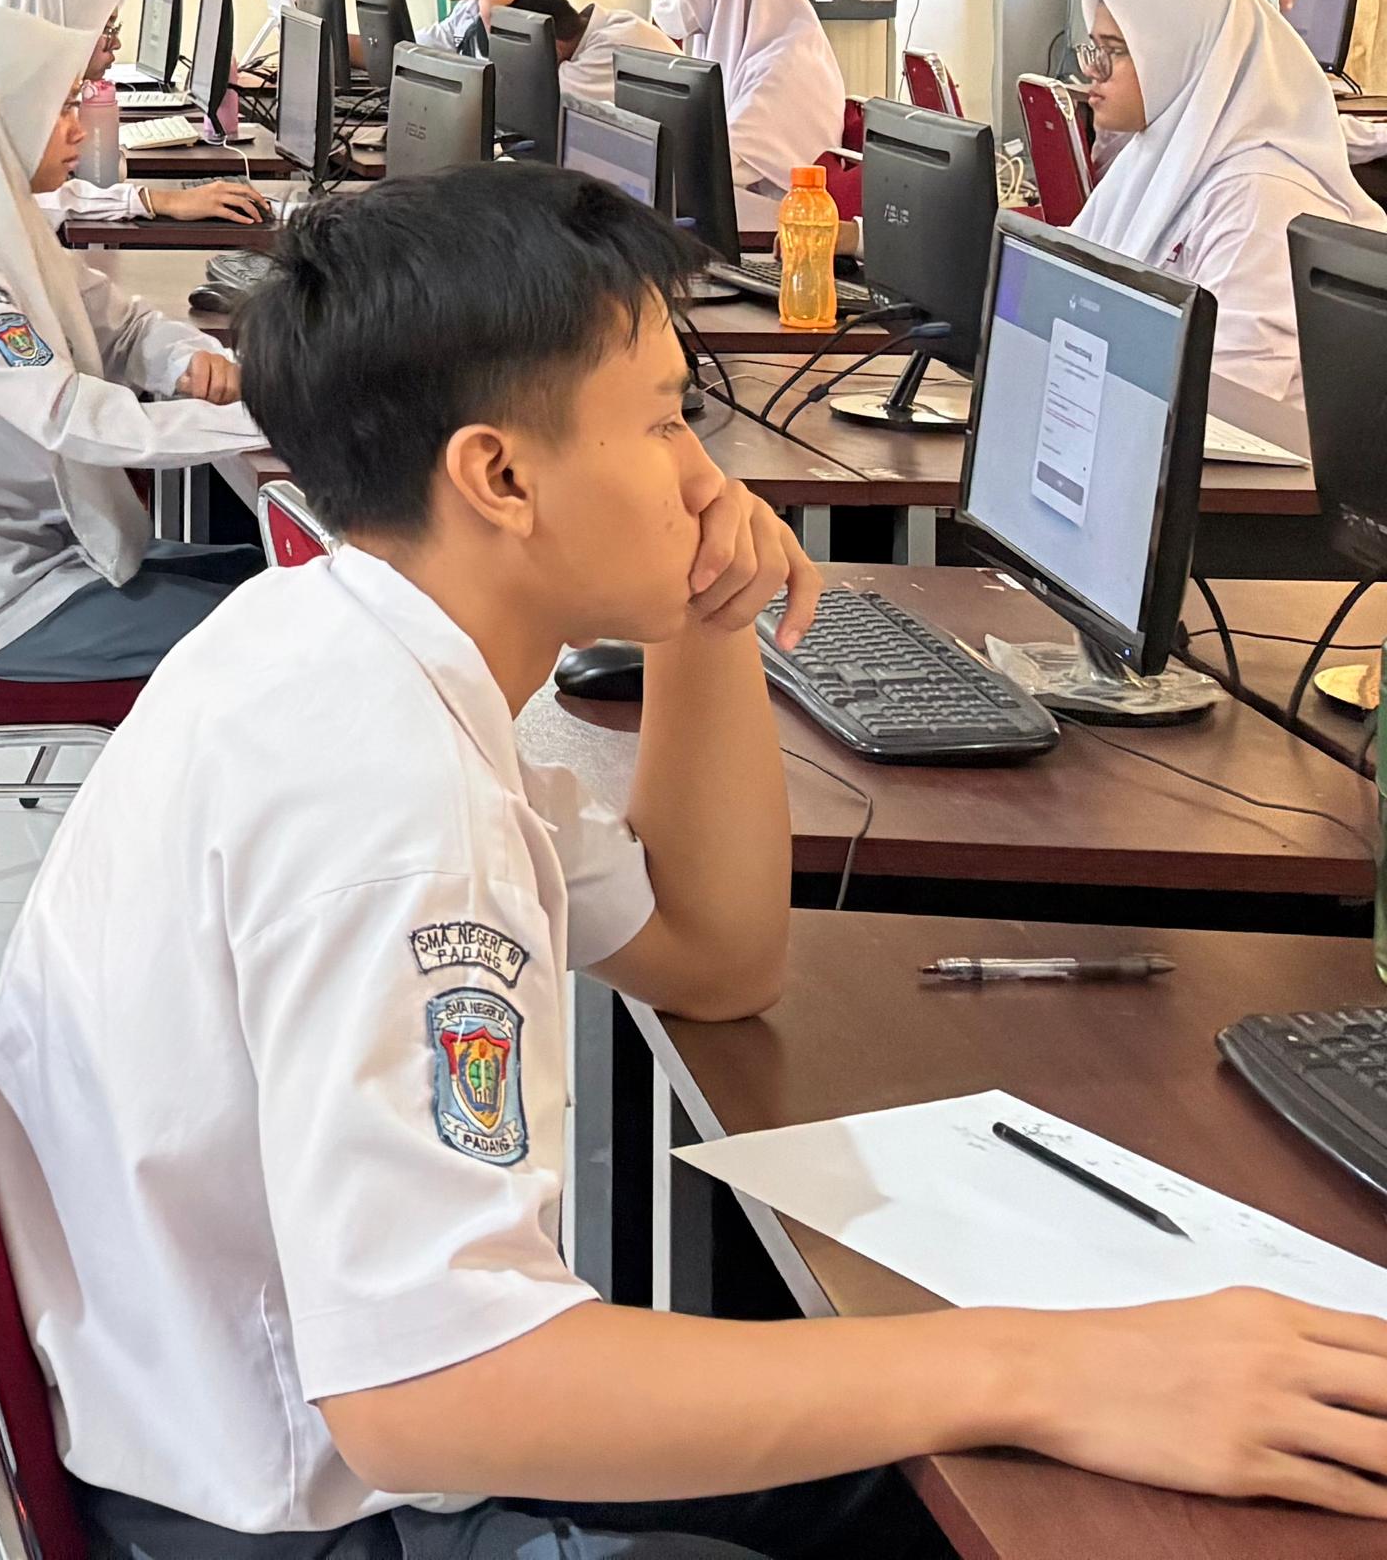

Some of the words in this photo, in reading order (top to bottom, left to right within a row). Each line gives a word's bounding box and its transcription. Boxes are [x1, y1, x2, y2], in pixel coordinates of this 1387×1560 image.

[417, 928, 450, 953] SMA
[458, 926, 503, 954] NEGERI
[507, 946, 521, 966] 10
[437, 946, 502, 970] PADANG
[463, 1134, 510, 1153] PADANG
